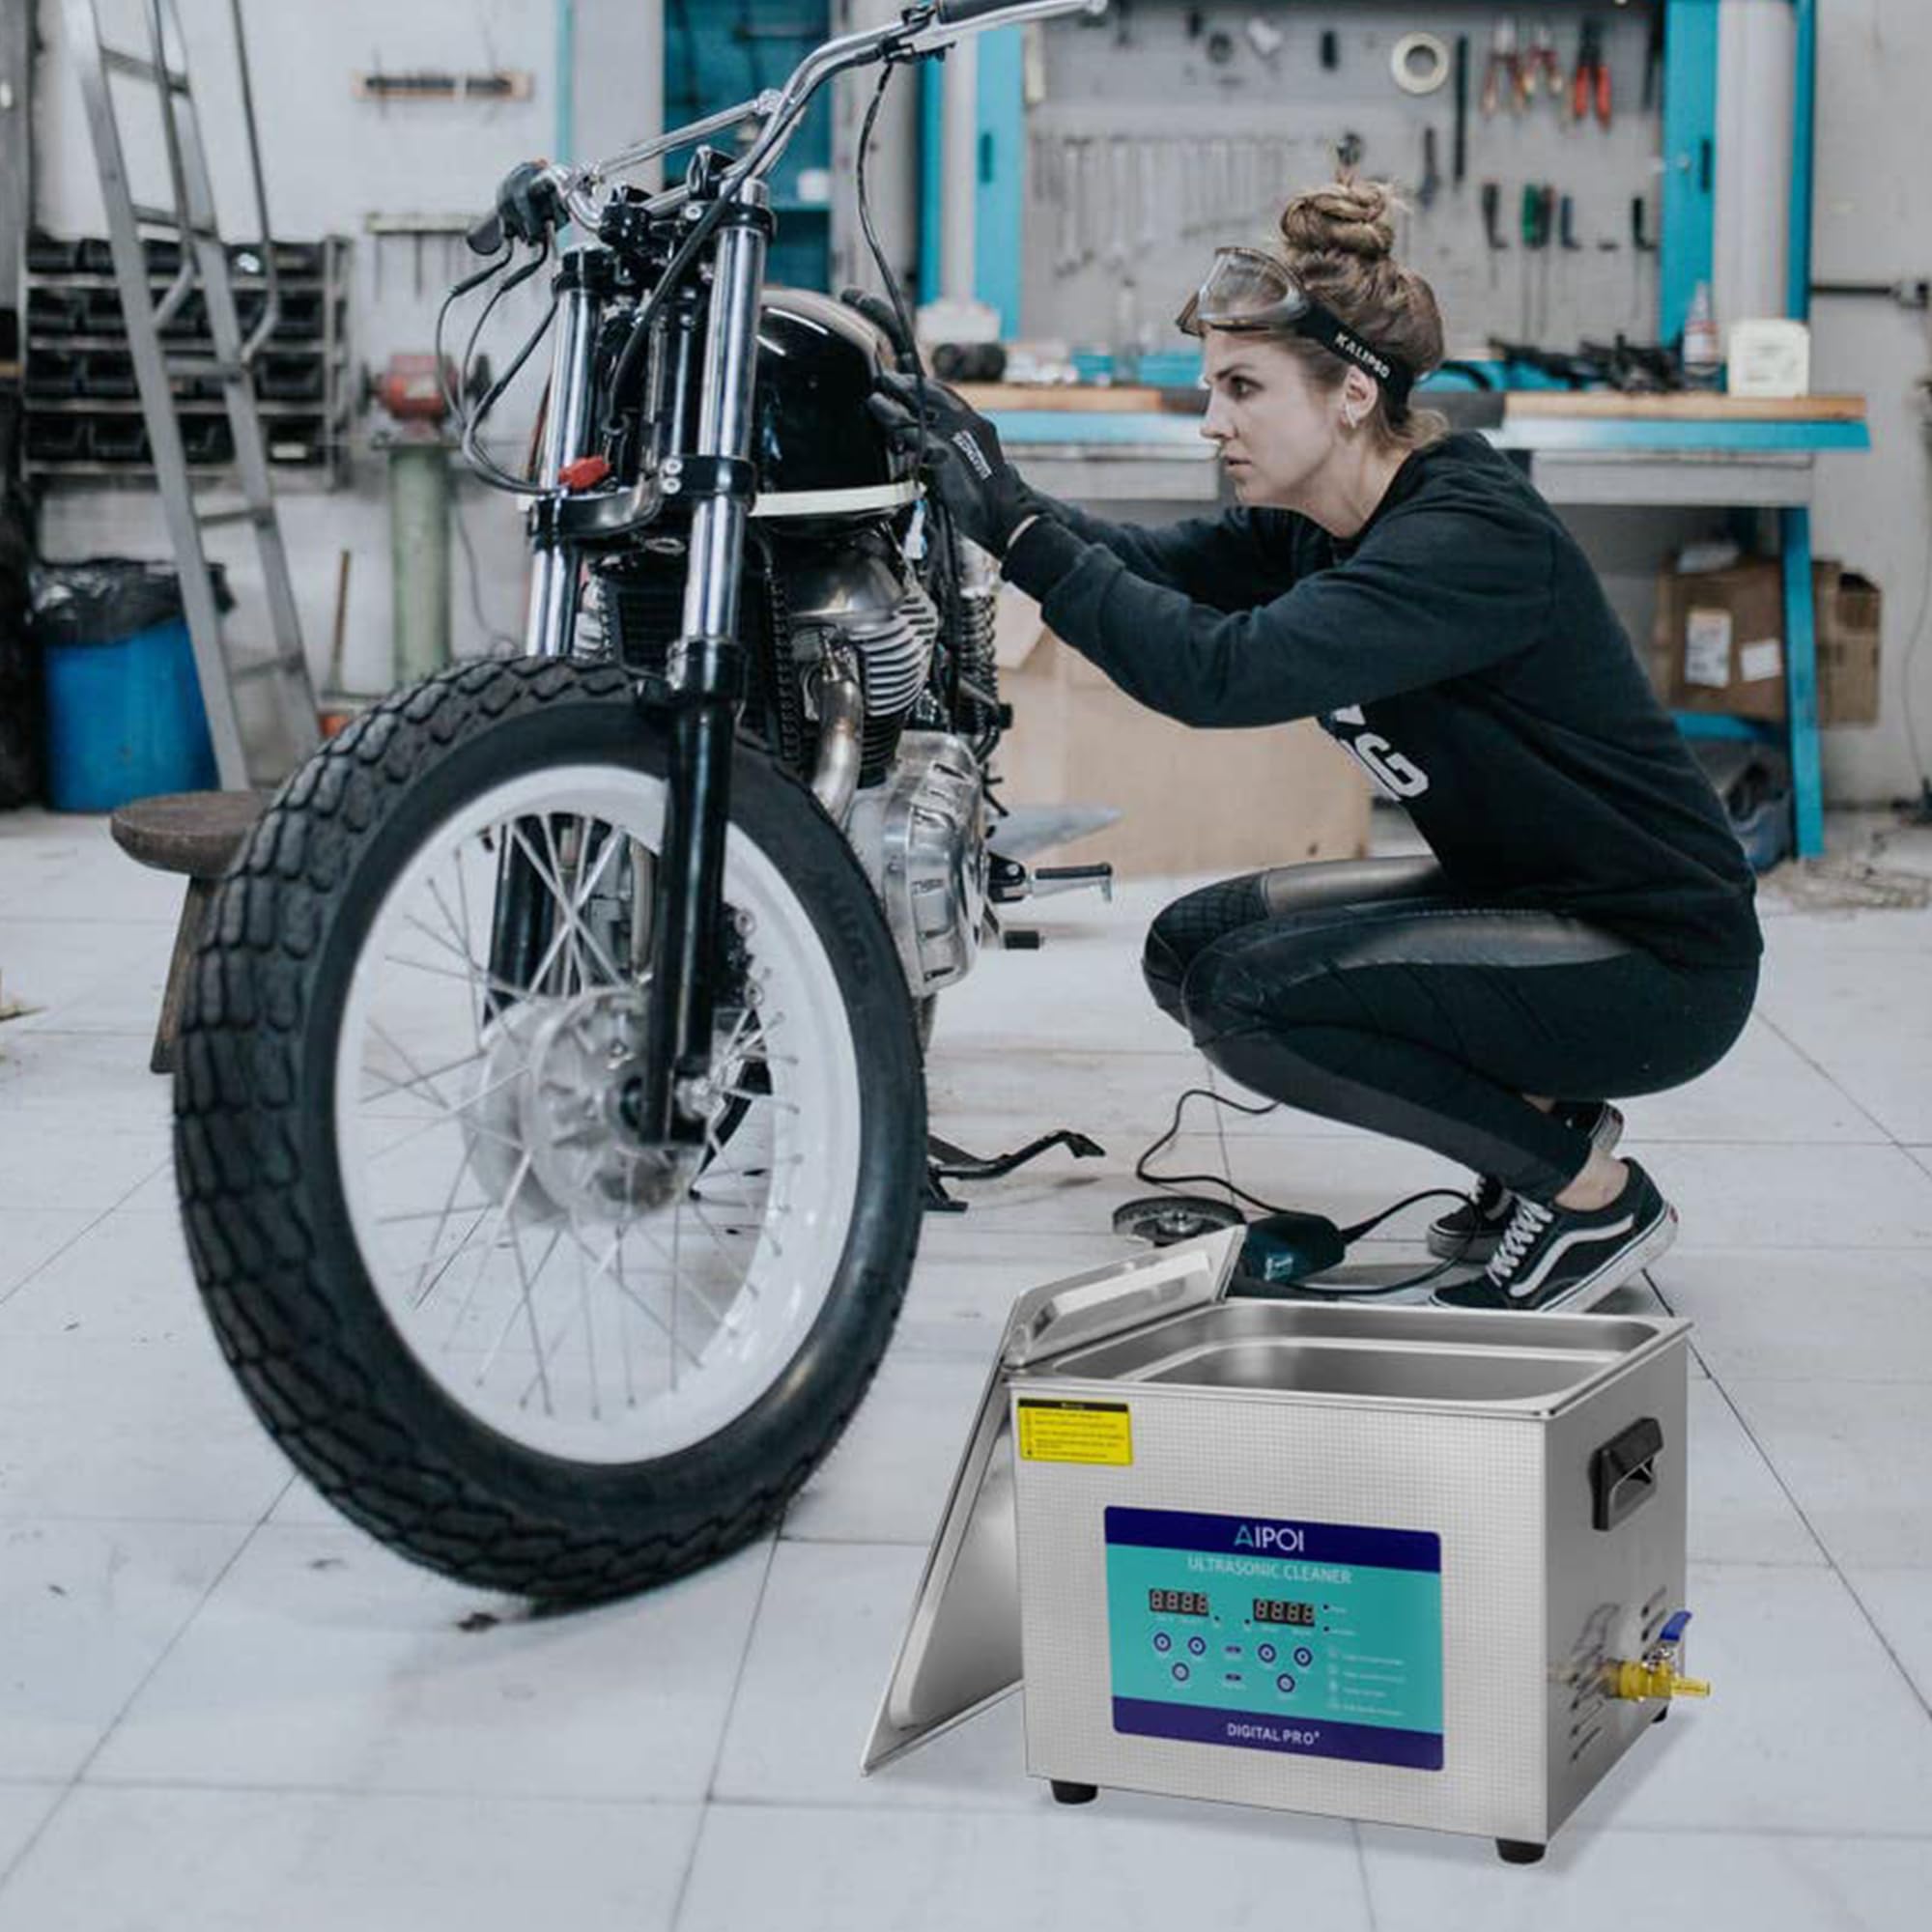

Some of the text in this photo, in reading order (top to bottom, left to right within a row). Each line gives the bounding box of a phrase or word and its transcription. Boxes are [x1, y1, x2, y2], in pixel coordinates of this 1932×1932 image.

[1234, 1523, 1304, 1552] AIPOI
[1187, 1555, 1352, 1584] ULTRASONIC CLEANER
[1227, 1722, 1280, 1742] DIGITAL
